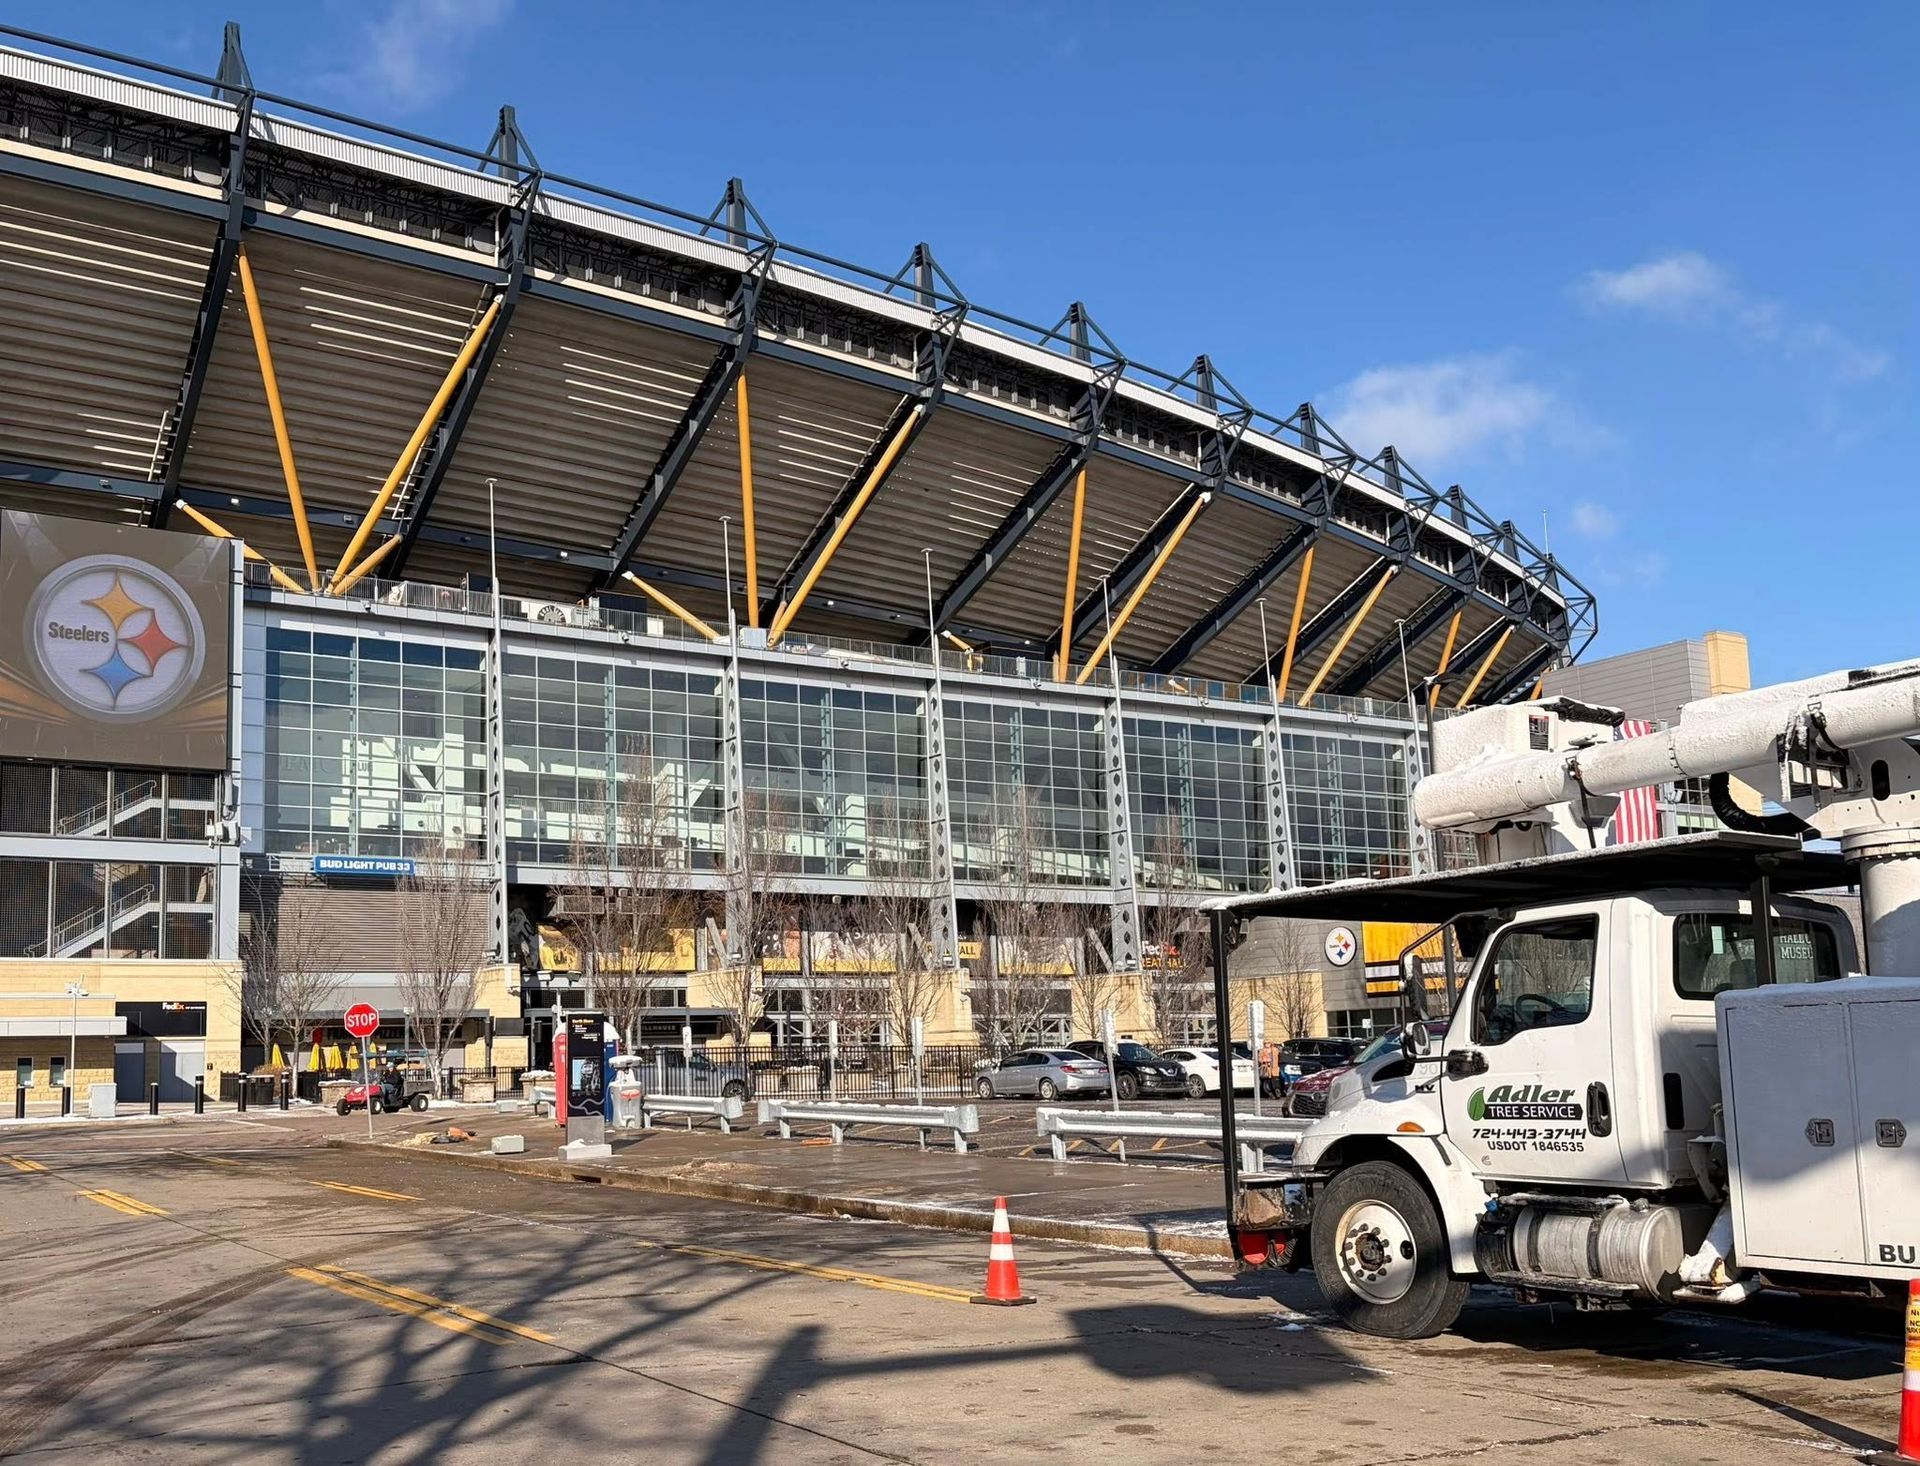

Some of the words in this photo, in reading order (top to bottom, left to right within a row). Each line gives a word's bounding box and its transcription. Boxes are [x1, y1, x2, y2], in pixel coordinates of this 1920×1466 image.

[48, 621, 110, 643] Steelers
[320, 859, 343, 869] BUD
[344, 860, 375, 870] LIGHT
[375, 862, 397, 871] PUB
[397, 862, 411, 871] 33
[162, 1002, 185, 1010] FedEx
[347, 1012, 376, 1028] STOP
[1487, 1085, 1576, 1103] Adler
[1488, 1105, 1520, 1118] TREE
[1521, 1105, 1576, 1118] SERVICE
[1472, 1128, 1587, 1140] 724-443-3744
[1487, 1141, 1528, 1151] USDOT
[1531, 1141, 1584, 1152] 1846535
